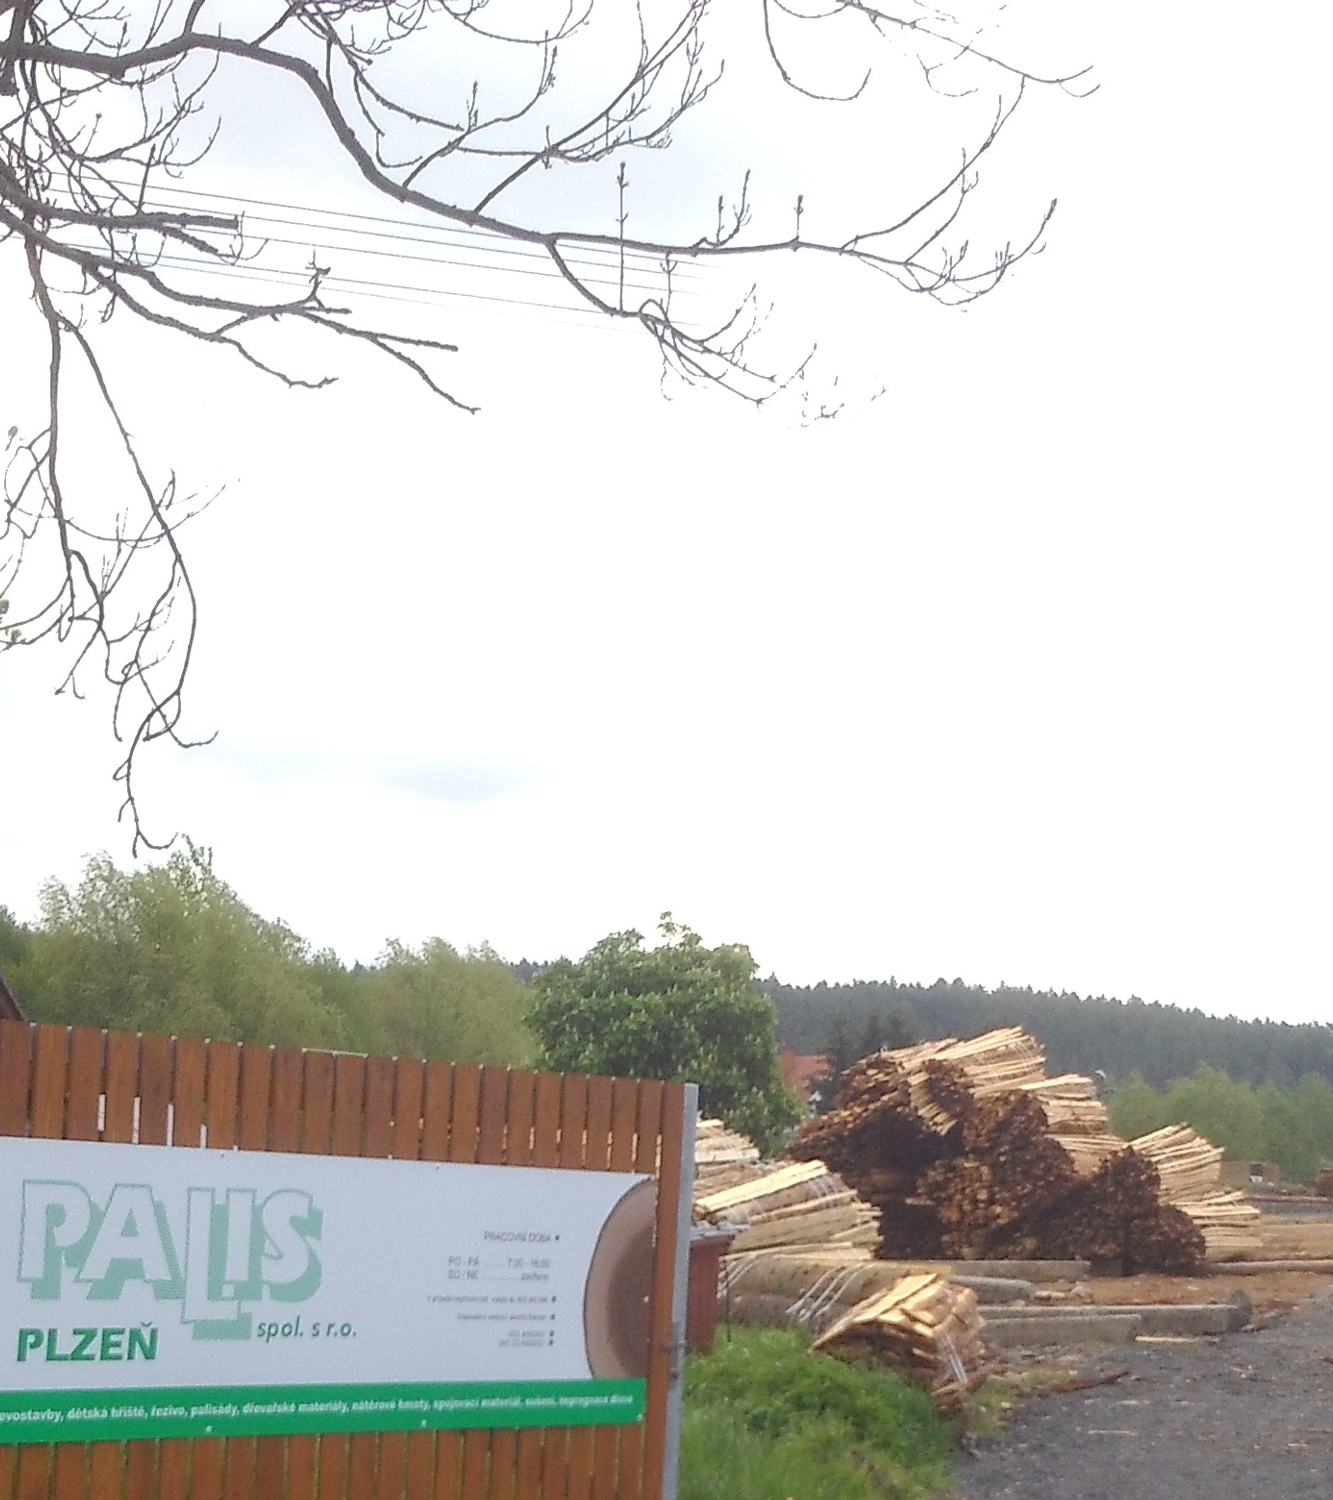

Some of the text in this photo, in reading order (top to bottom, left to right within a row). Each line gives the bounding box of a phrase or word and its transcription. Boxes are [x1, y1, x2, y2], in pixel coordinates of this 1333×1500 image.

[17, 1178, 324, 1340] PALIS
[17, 1321, 159, 1361] PLZEŇ
[257, 1316, 358, 1343] spol. s r.o.
[67, 1405, 109, 1420] dětská
[111, 1403, 148, 1419] hřiště,
[150, 1403, 188, 1418] řezivo,
[191, 1402, 240, 1417] palisády,
[243, 1400, 296, 1414] dřevařské
[299, 1399, 349, 1414] materiály,
